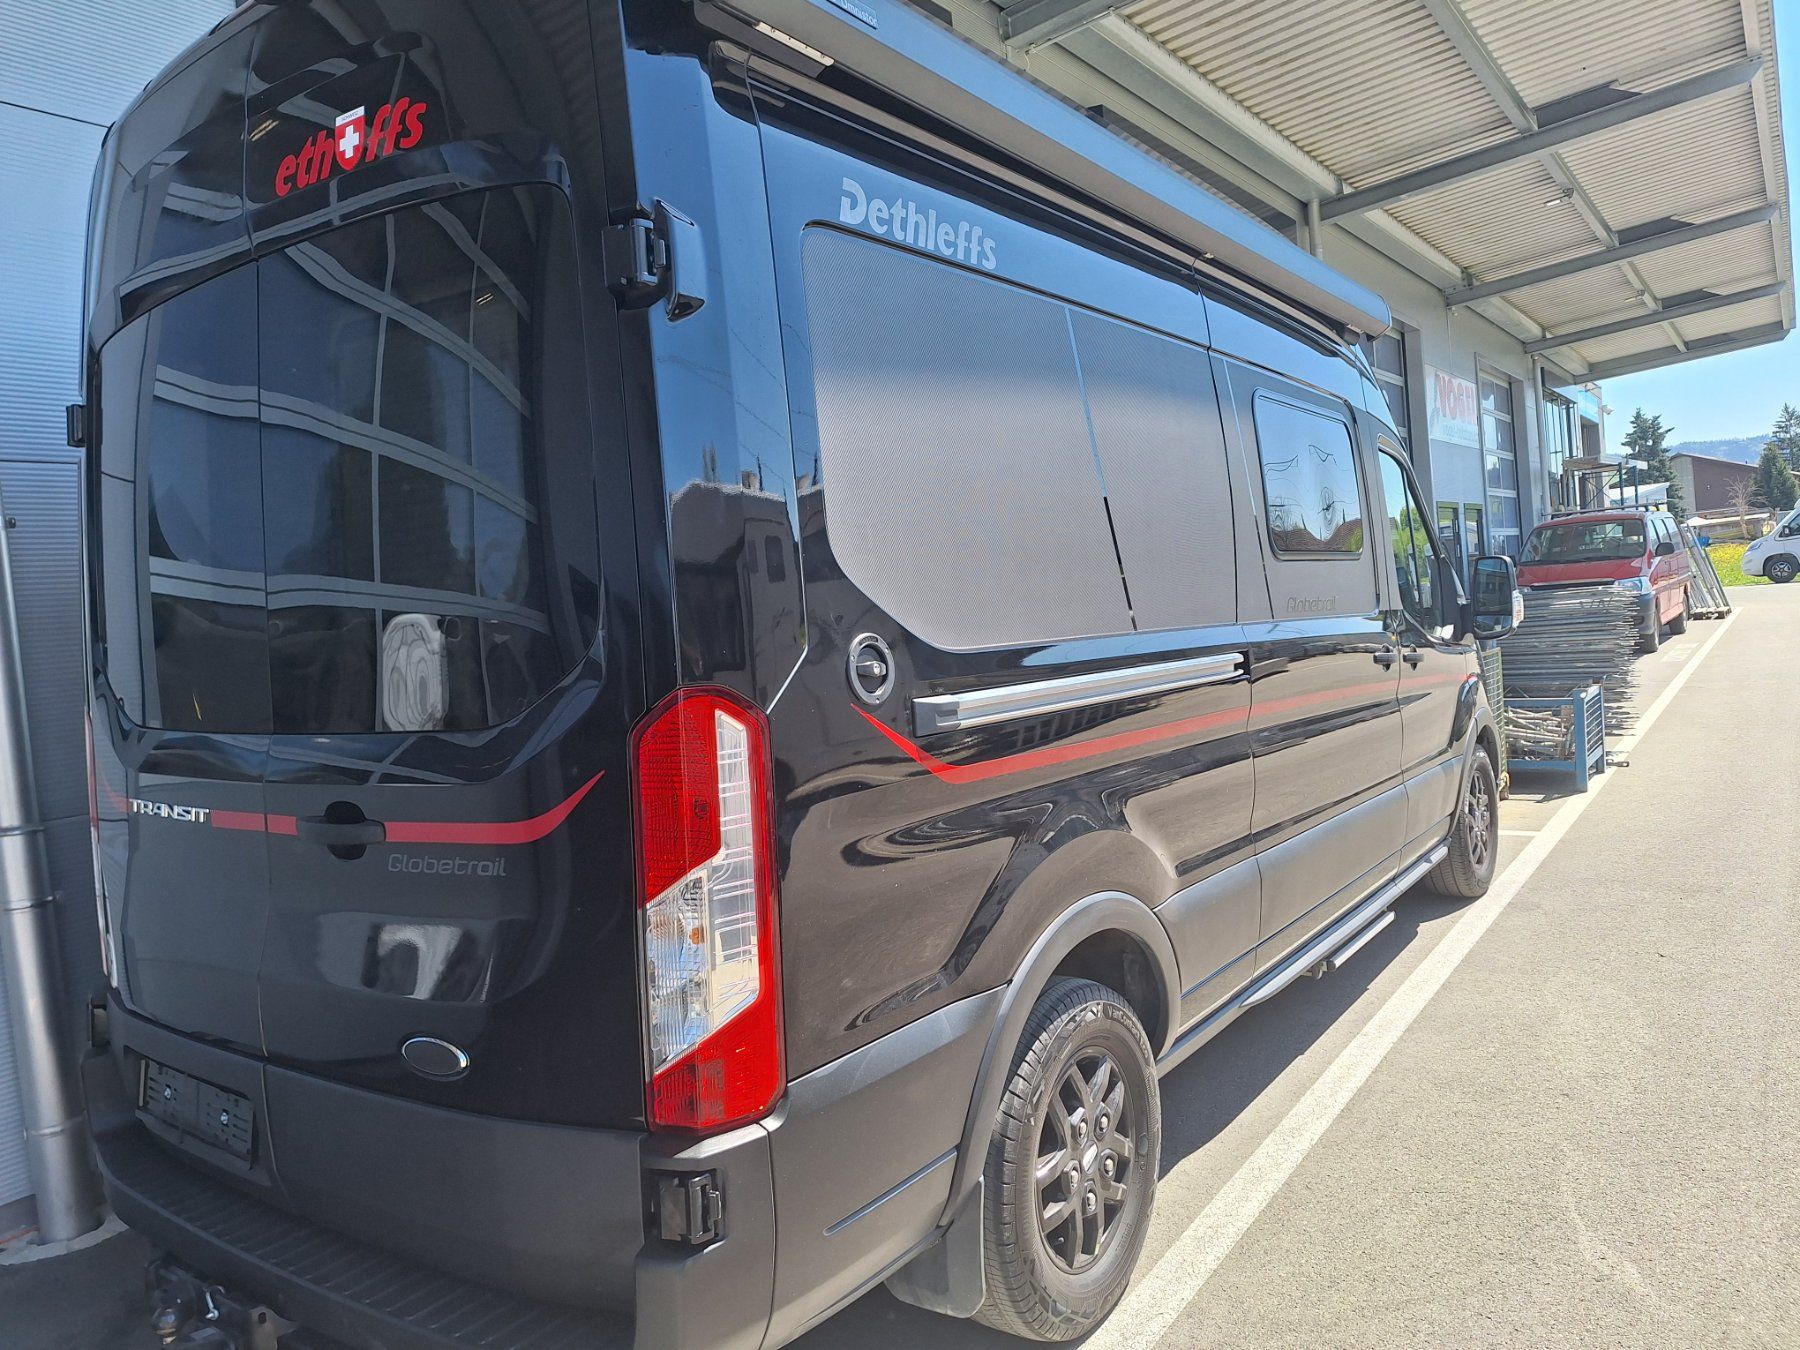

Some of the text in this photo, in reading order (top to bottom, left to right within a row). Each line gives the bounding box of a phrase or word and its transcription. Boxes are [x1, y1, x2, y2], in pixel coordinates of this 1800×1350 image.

[839, 177, 997, 270] Dethleffs
[128, 798, 210, 823] TRANSIT
[388, 853, 506, 876] Globetrail
